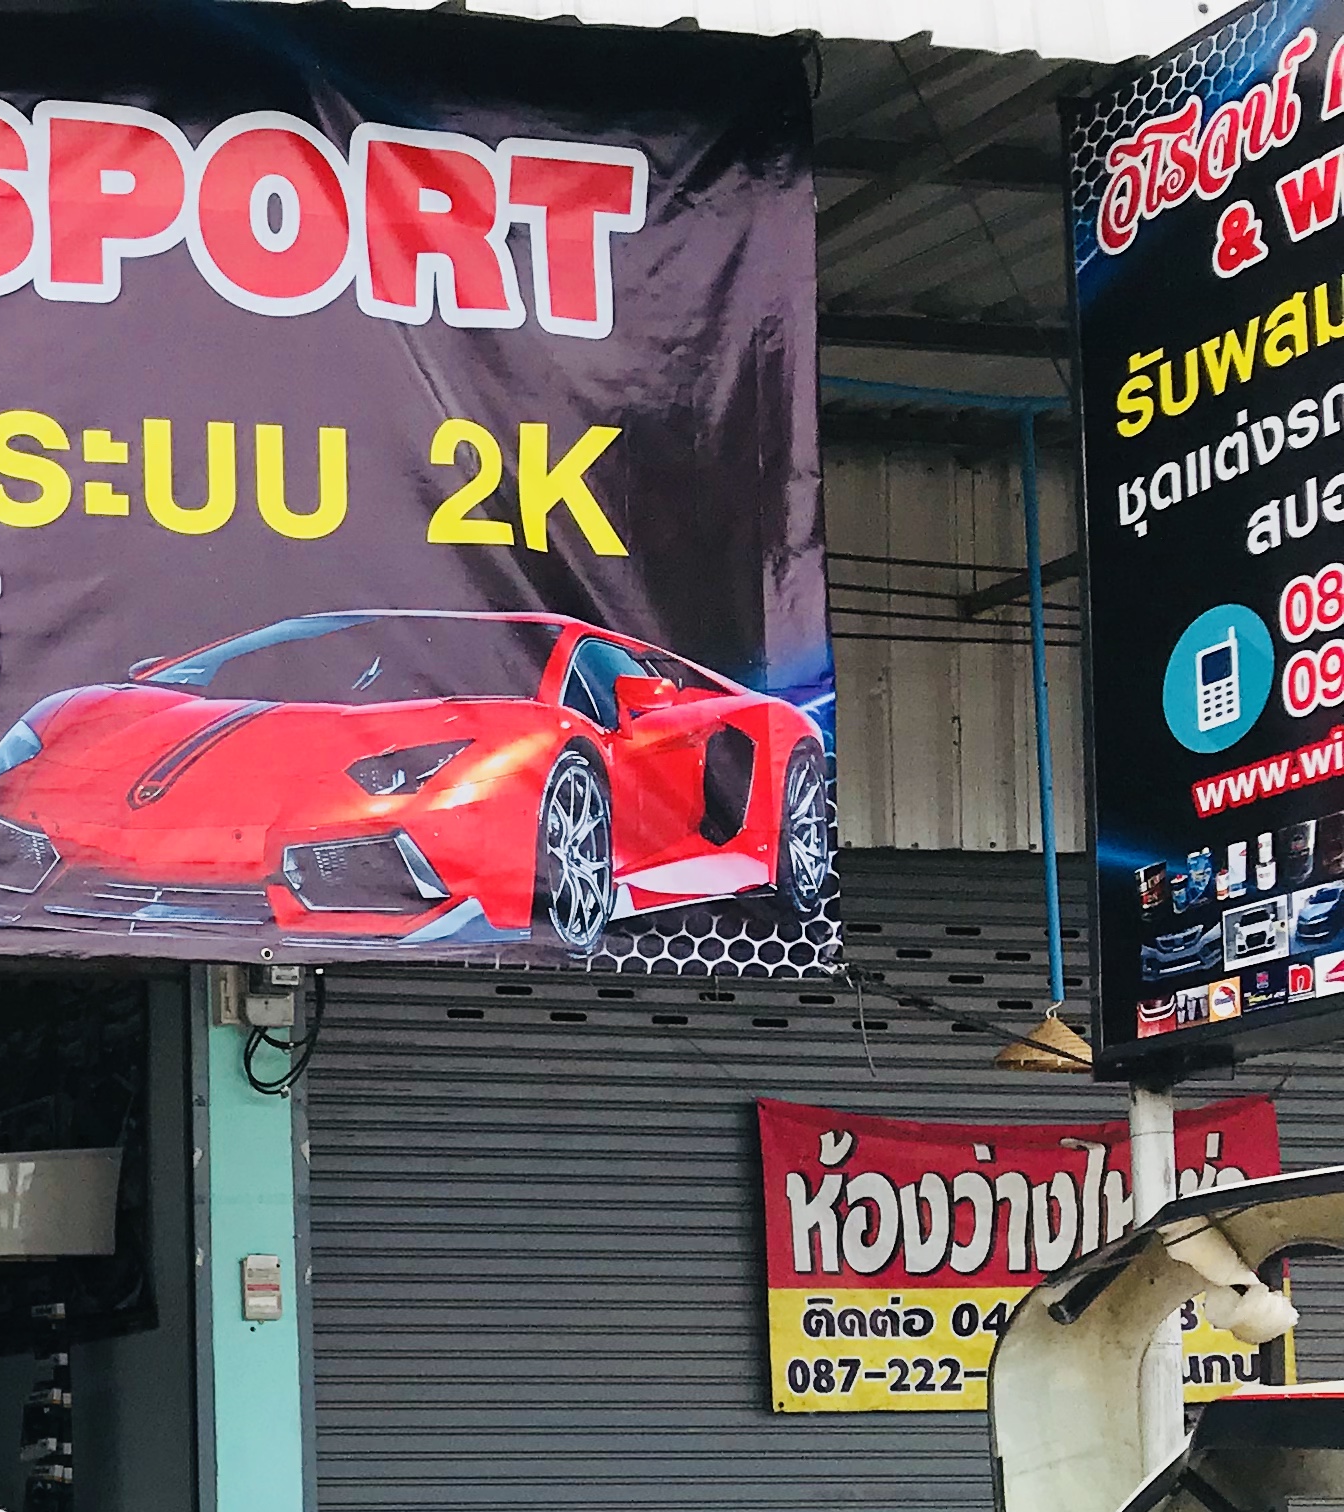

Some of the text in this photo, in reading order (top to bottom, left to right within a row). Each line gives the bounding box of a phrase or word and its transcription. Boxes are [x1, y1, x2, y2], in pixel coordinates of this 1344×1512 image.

[1213, 200, 1269, 278] &
[426, 417, 629, 558] 2K
[803, 1296, 934, 1338] ติดต่อ
